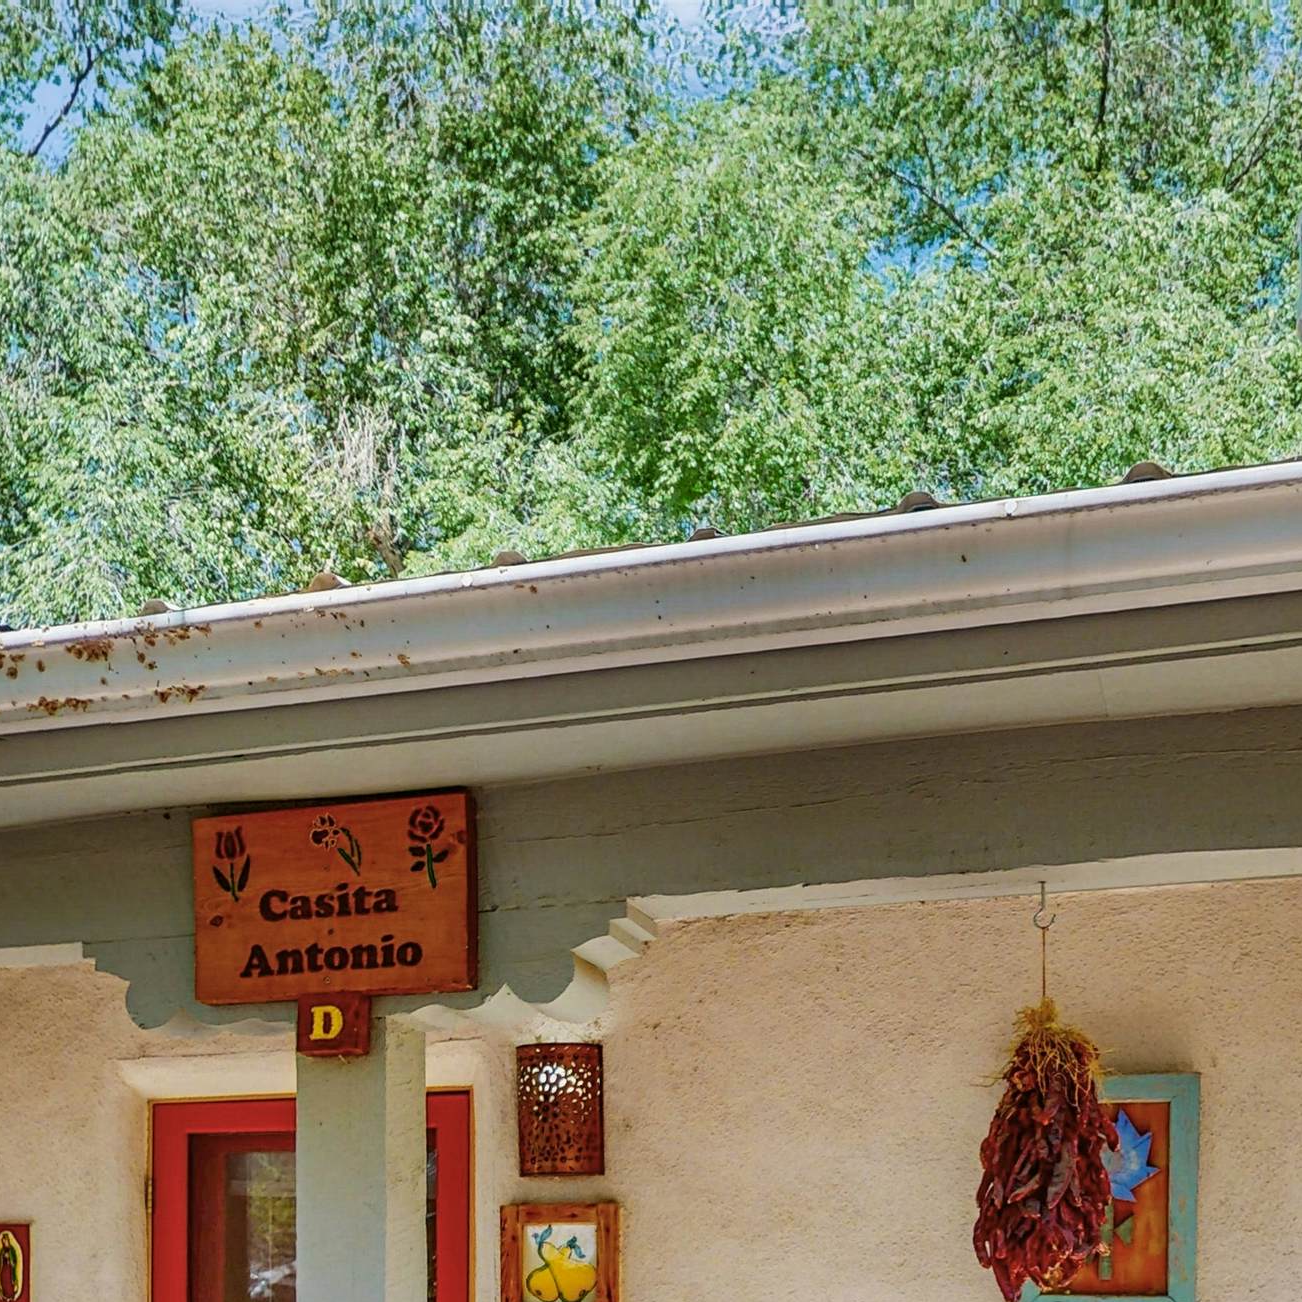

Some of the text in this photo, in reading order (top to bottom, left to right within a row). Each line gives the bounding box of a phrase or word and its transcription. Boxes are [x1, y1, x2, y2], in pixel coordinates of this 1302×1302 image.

[259, 883, 398, 921] Casita
[239, 935, 423, 978] Antonio
[309, 1005, 343, 1040] D
